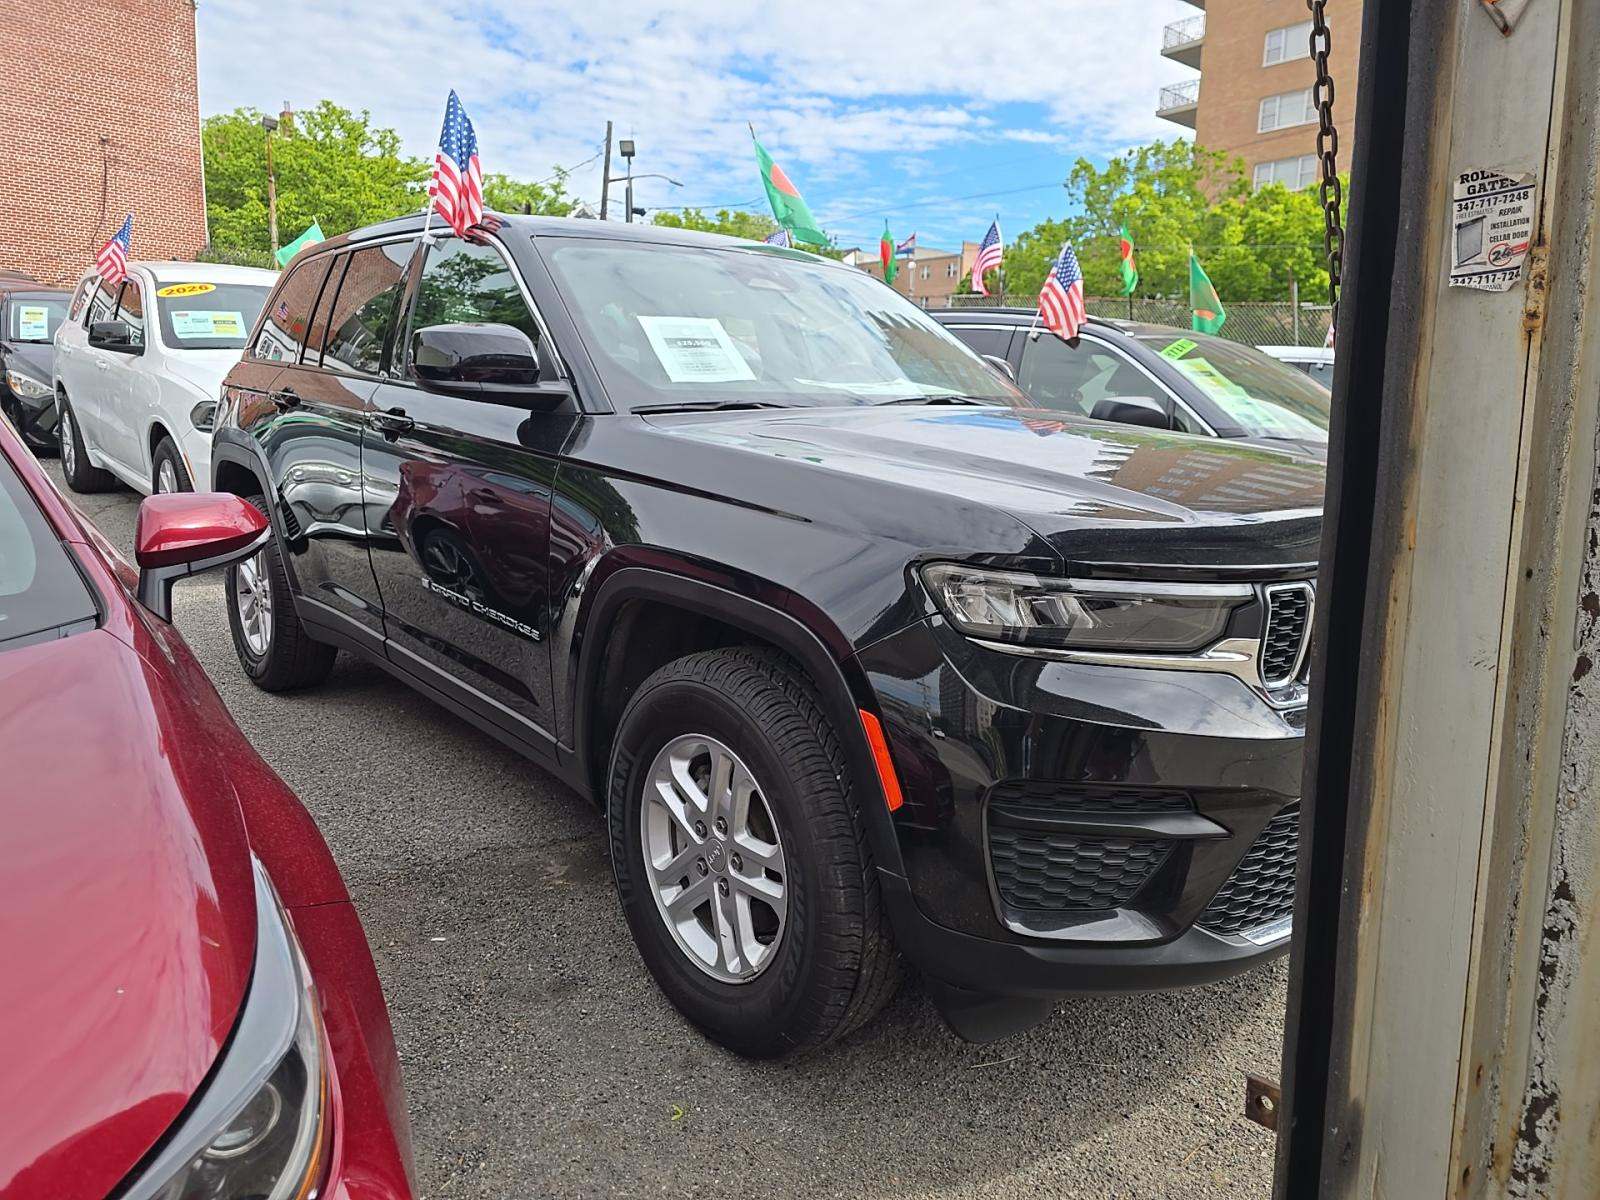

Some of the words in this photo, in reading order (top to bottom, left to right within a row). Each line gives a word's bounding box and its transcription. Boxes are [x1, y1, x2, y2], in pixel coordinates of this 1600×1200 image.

[1457, 191, 1529, 212] 347-717-7248
[1499, 206, 1523, 217] REPAIR
[1490, 217, 1530, 230] INSTALLATION
[1489, 233, 1511, 243] CELLAR
[1512, 230, 1529, 239] DOOR
[472, 601, 540, 641] CHEROKEE
